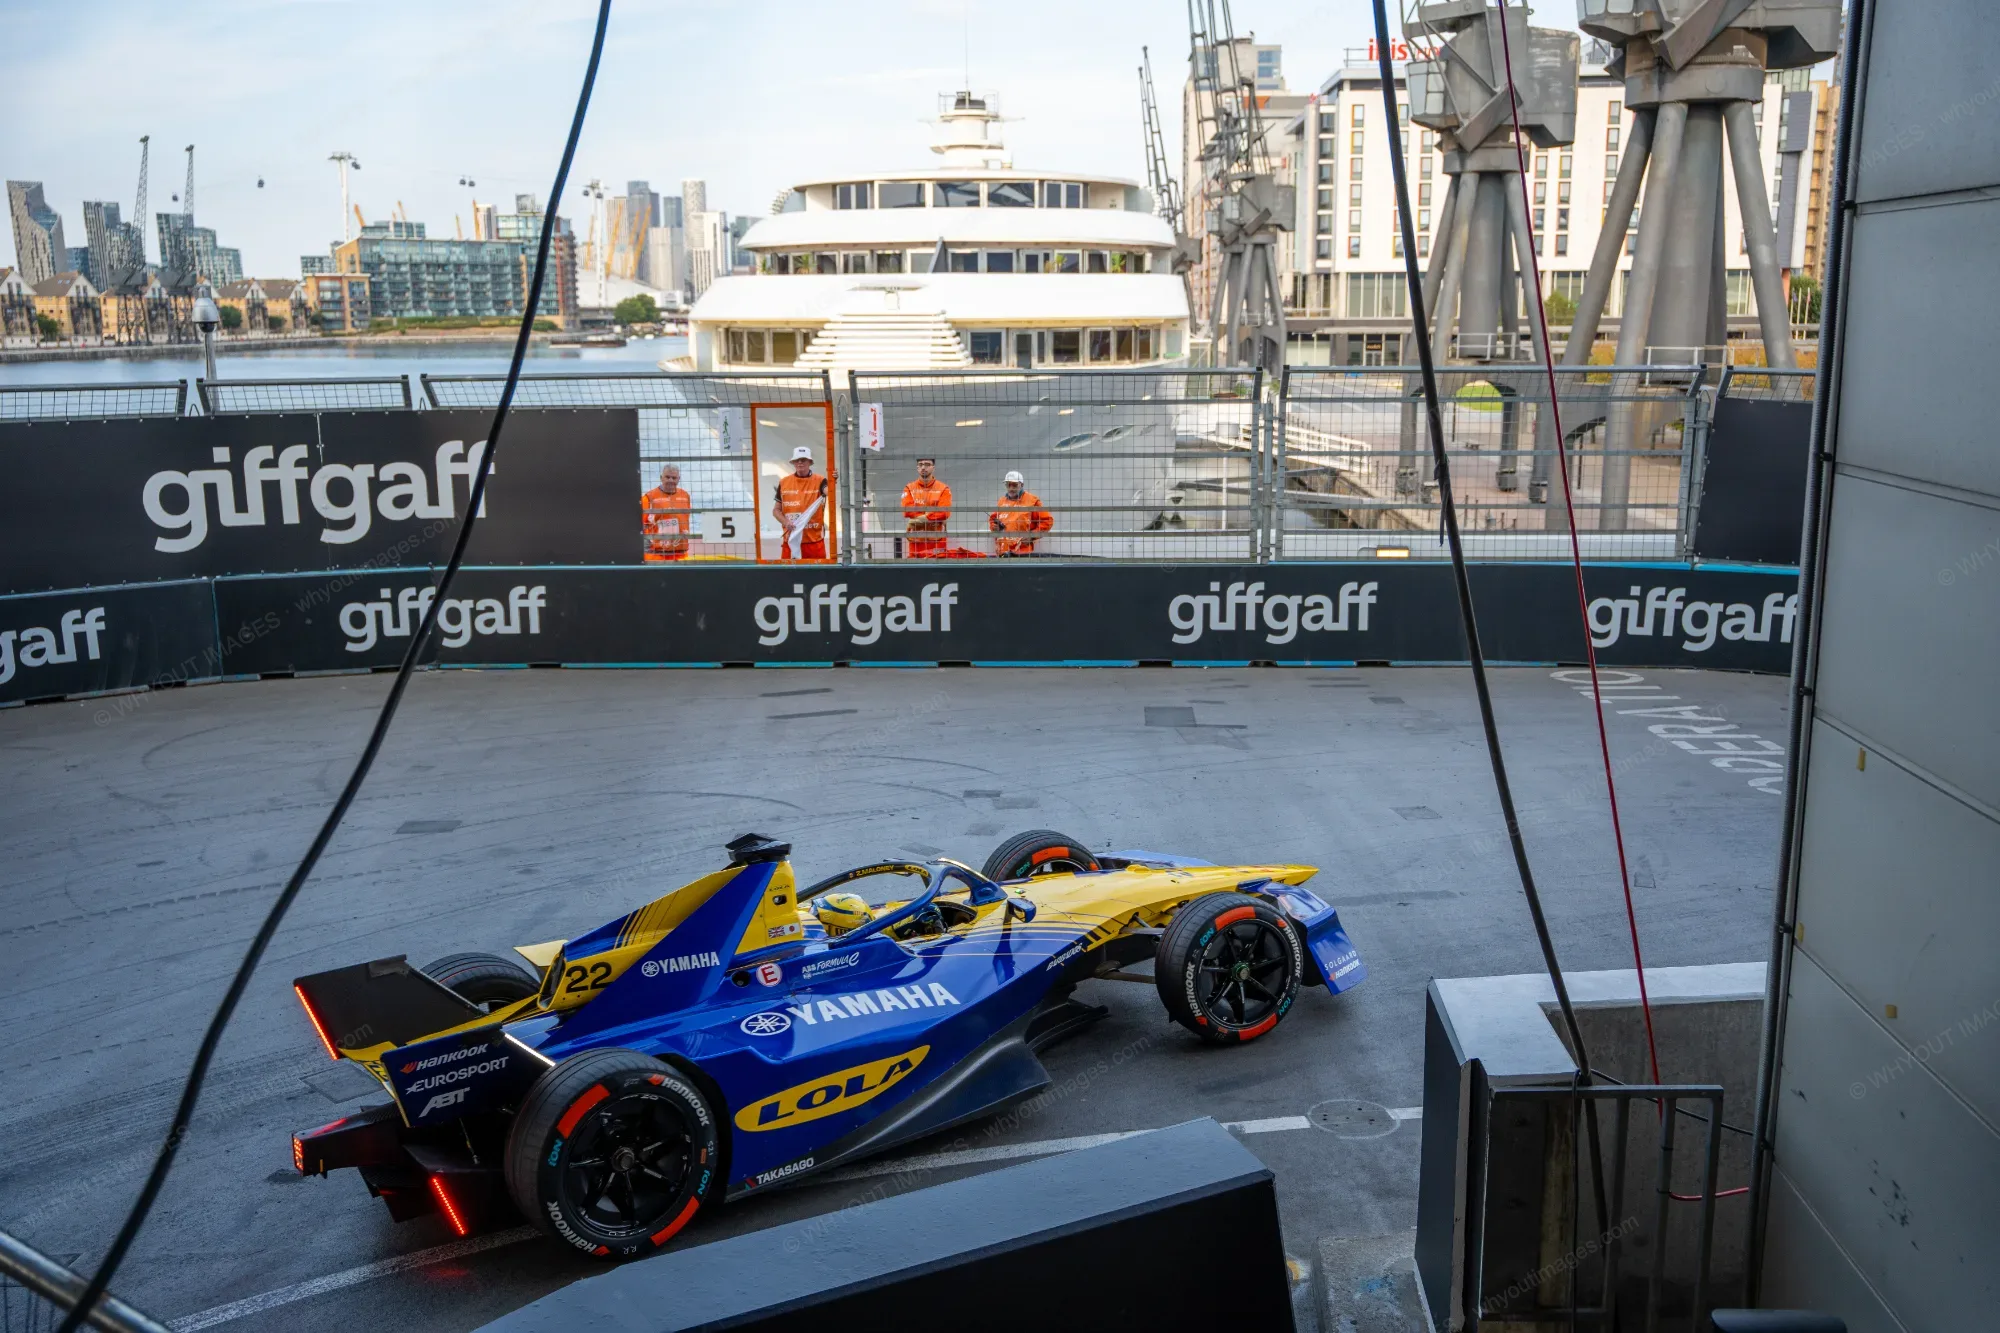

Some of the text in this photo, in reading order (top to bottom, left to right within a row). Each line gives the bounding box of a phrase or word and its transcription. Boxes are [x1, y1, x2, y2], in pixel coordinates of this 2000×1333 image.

[142, 440, 496, 553] giffgaff
[721, 517, 736, 538] 5
[339, 585, 547, 652] giffgaff
[754, 583, 959, 646] giffgaff
[1168, 582, 1379, 645] giffgaff
[659, 951, 721, 974] YAMAHA
[761, 966, 777, 984] E
[1324, 950, 1357, 971] SOLGAARD
[565, 962, 613, 993] 22
[790, 982, 960, 1027] YAMAHA
[410, 1056, 510, 1092] EUROSPORT
[418, 1087, 471, 1118] ABT
[757, 1058, 914, 1127] LOLA
[755, 1157, 815, 1186] TAKASAGO
